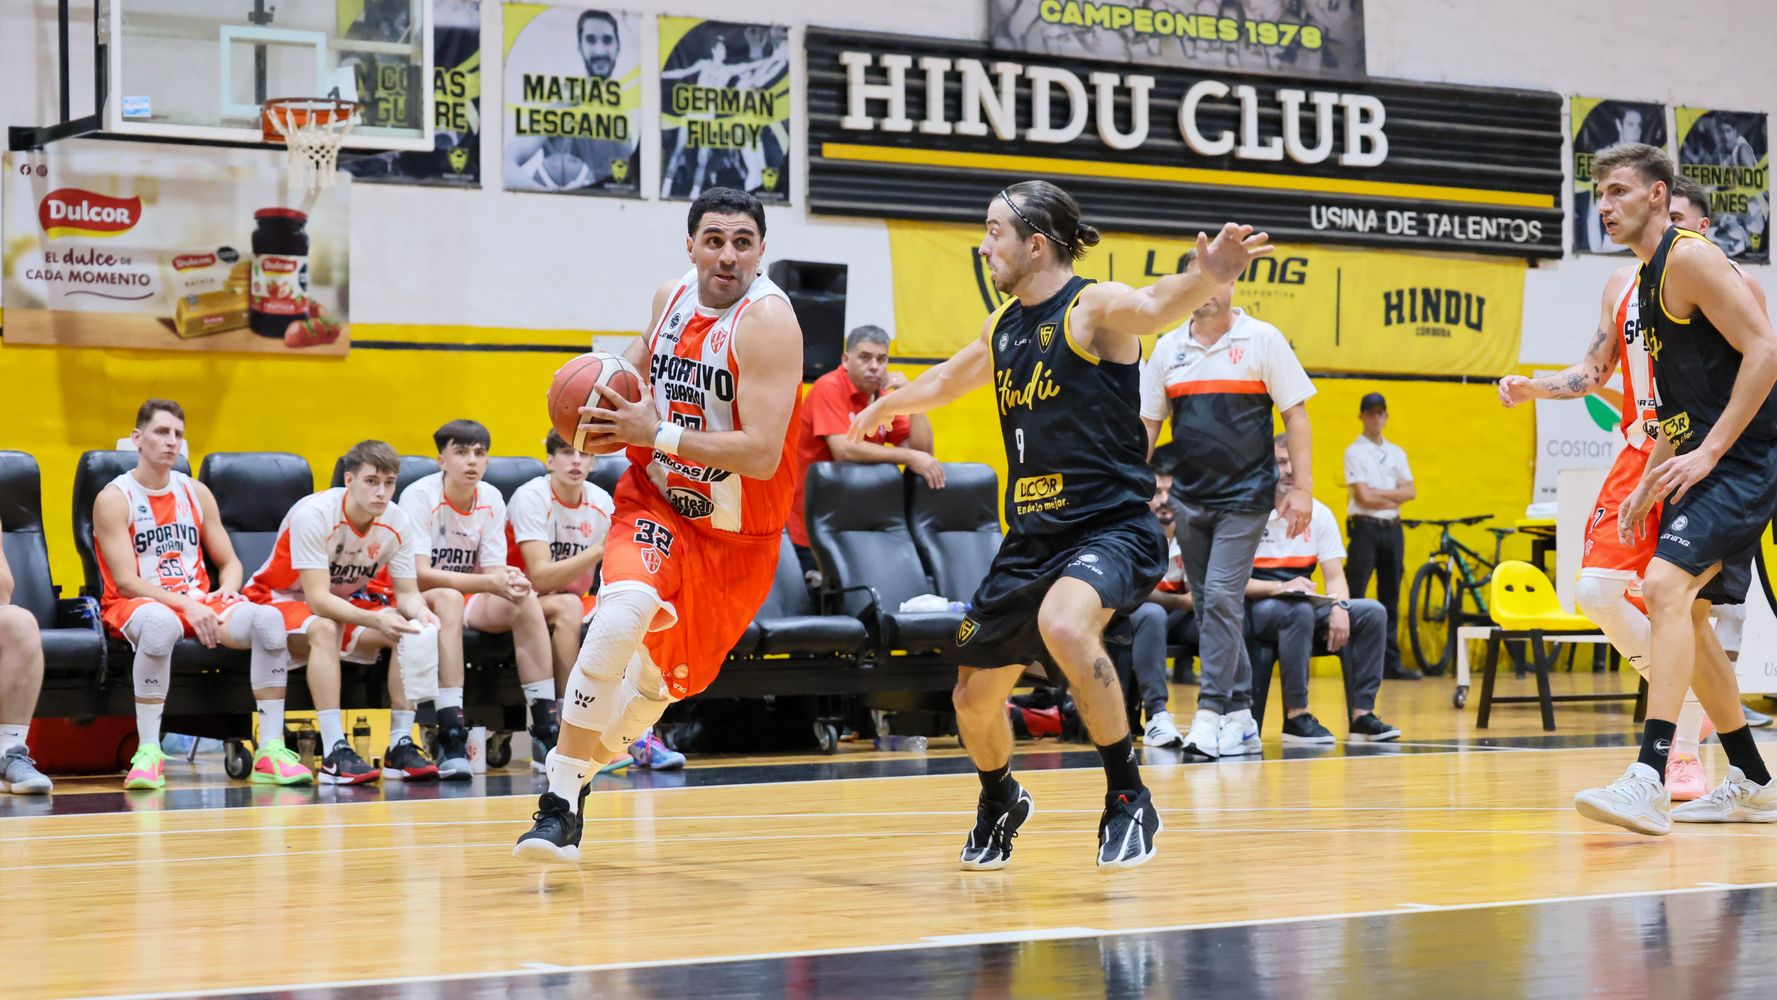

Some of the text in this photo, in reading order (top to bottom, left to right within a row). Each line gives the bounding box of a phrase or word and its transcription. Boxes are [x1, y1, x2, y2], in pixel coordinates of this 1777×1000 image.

[1040, 0, 1323, 49] CAMPEONES 1978
[523, 73, 621, 107] MATIAS
[675, 85, 775, 117] GERMAN
[515, 107, 629, 141] LESCANO
[839, 51, 1390, 168] HINDU CLUB
[687, 119, 763, 149] FILLOY
[1310, 204, 1543, 244] USINA DE TALENTOS
[45, 251, 59, 263] EL
[63, 247, 118, 266] dulce
[26, 268, 151, 286] CADA MOMENTO
[1383, 287, 1486, 332] HINDU
[1015, 428, 1025, 463] 9
[634, 518, 674, 557] 32
